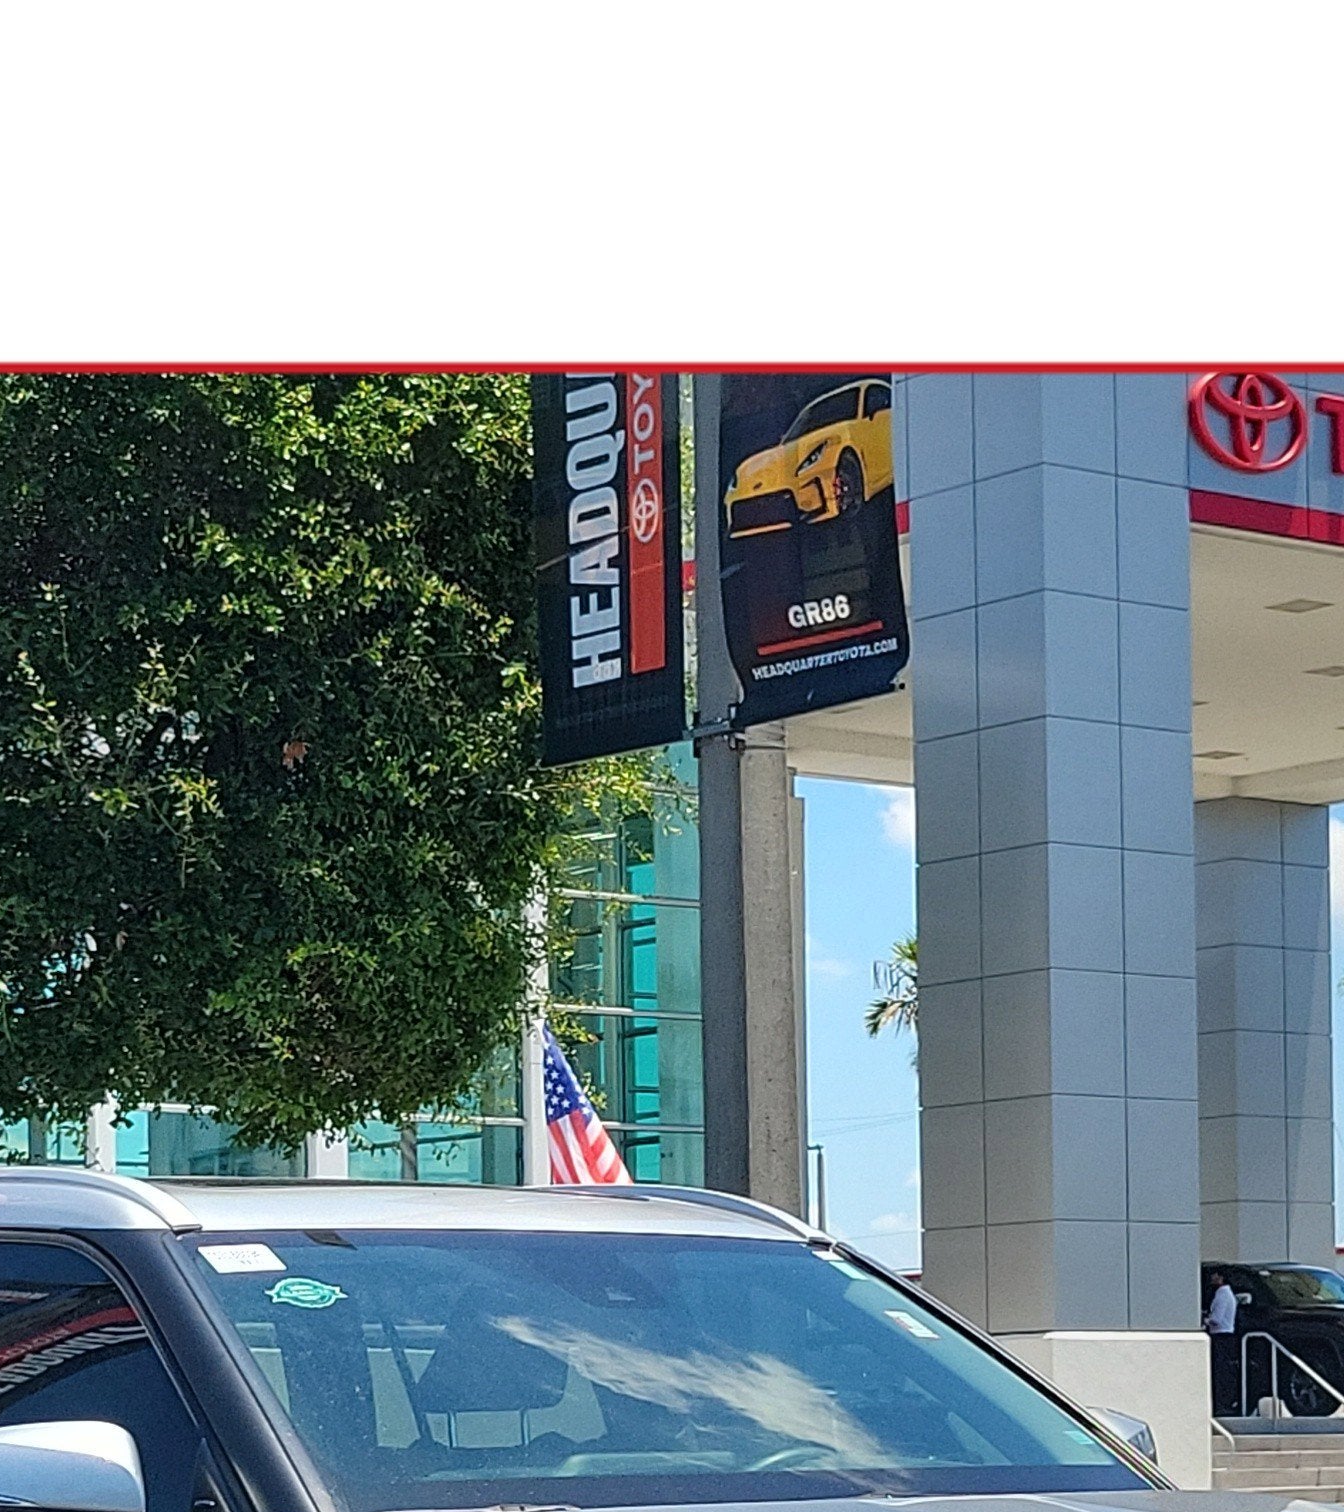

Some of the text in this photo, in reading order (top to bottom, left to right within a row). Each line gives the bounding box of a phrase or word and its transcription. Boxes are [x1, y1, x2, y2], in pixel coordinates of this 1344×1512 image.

[565, 373, 625, 688] HEADQU
[788, 595, 851, 629] GR86
[752, 637, 899, 681] HEADQUARTERTOYOTA.COM
